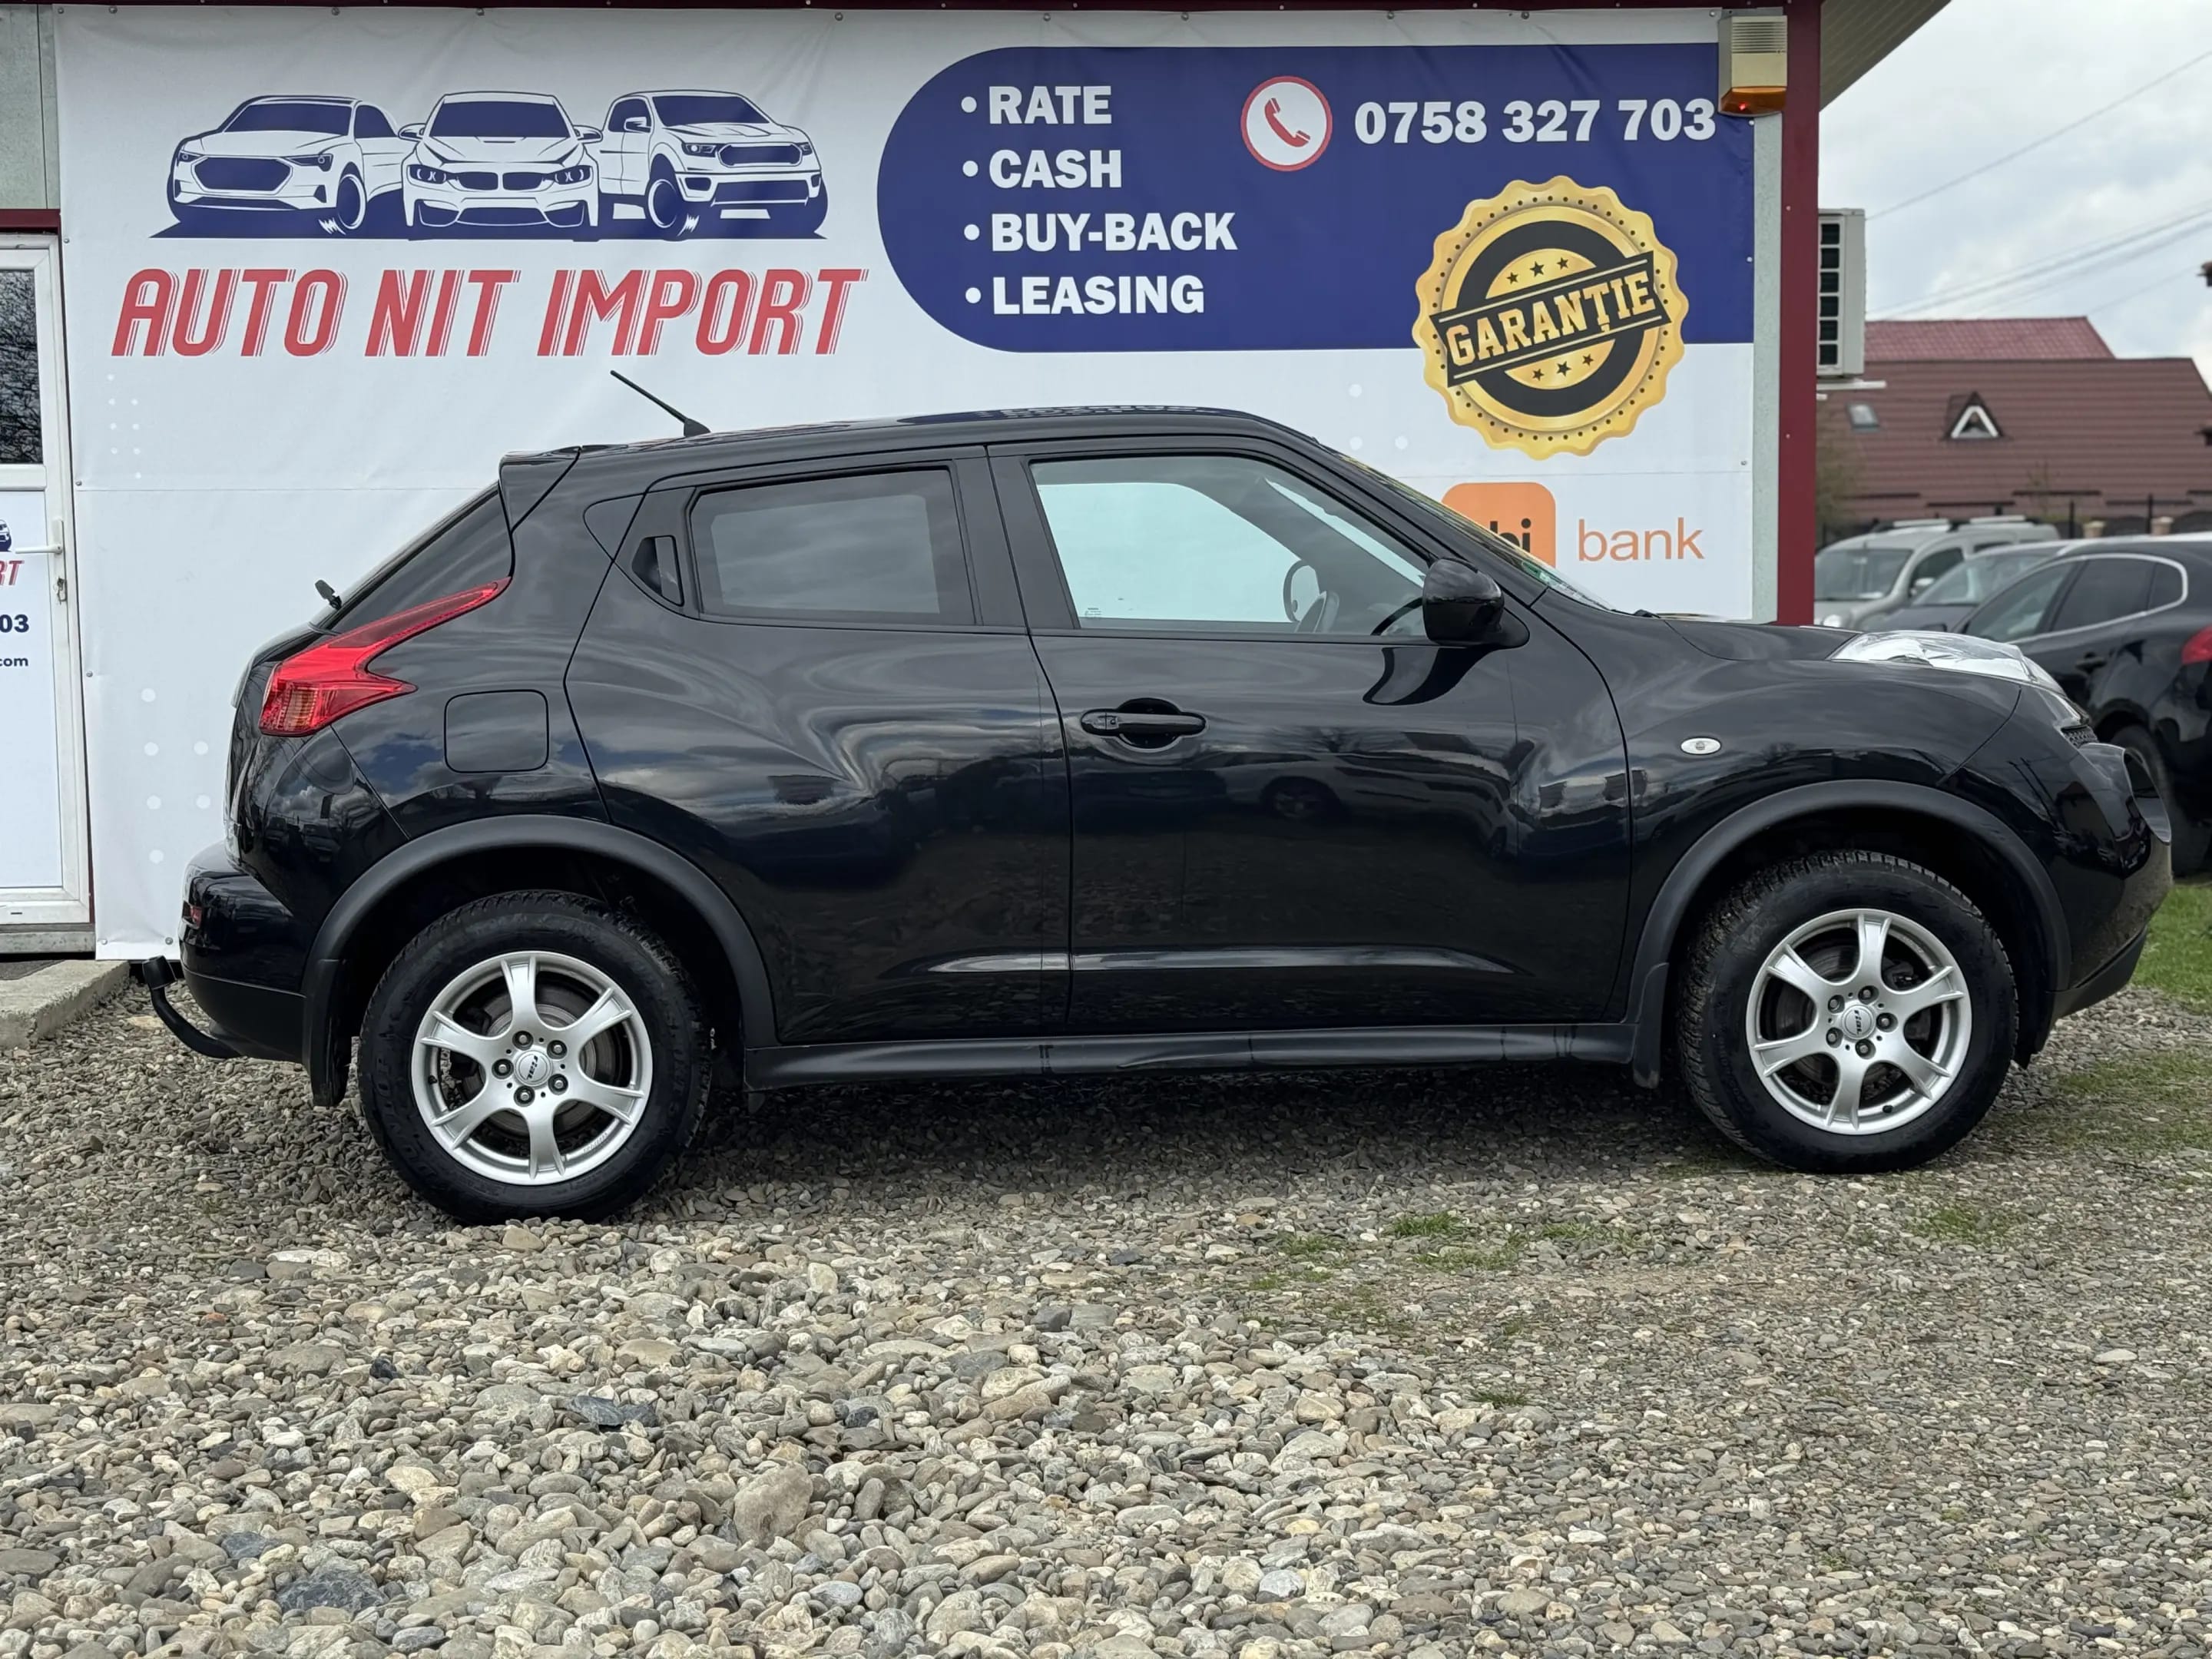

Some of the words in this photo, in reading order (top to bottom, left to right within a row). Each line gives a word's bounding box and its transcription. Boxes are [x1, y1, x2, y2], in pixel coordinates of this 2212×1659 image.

[988, 85, 1112, 124] RATE
[1355, 101, 1487, 144] 0758
[1502, 99, 1600, 143] 327
[1618, 98, 1716, 141] 703
[988, 149, 1122, 189] CASH
[992, 212, 1238, 252] BUY-BACK
[111, 269, 347, 357] AUTO
[365, 269, 521, 357] NIT
[537, 268, 868, 357] IMPORT
[992, 274, 1204, 315] LEASING
[1578, 516, 1703, 561] bank
[0, 614, 30, 634] 03
